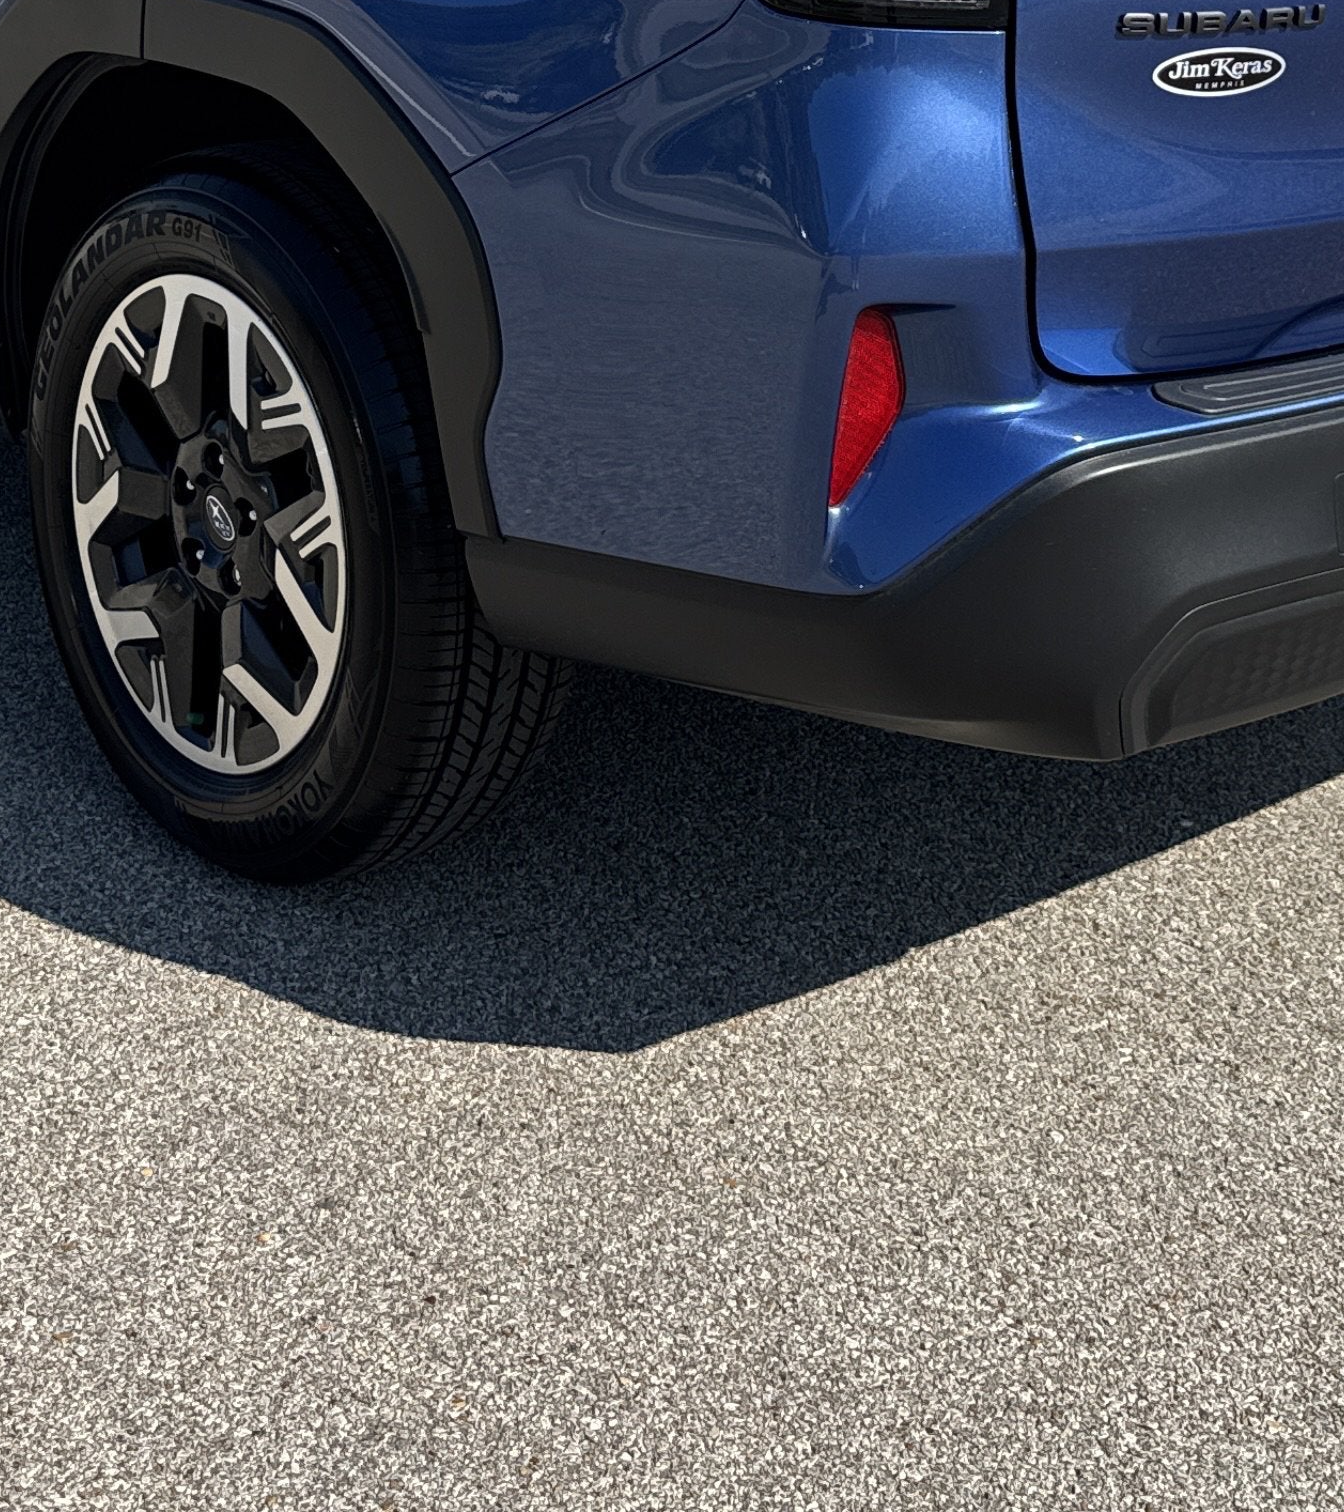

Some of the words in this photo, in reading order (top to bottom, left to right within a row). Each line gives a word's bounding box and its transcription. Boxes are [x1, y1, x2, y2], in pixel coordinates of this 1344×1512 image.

[1168, 61, 1210, 79] Jim
[1210, 57, 1273, 79] Keras
[1195, 80, 1245, 90] MEMPHIS
[36, 209, 166, 401] GEOLANDAR
